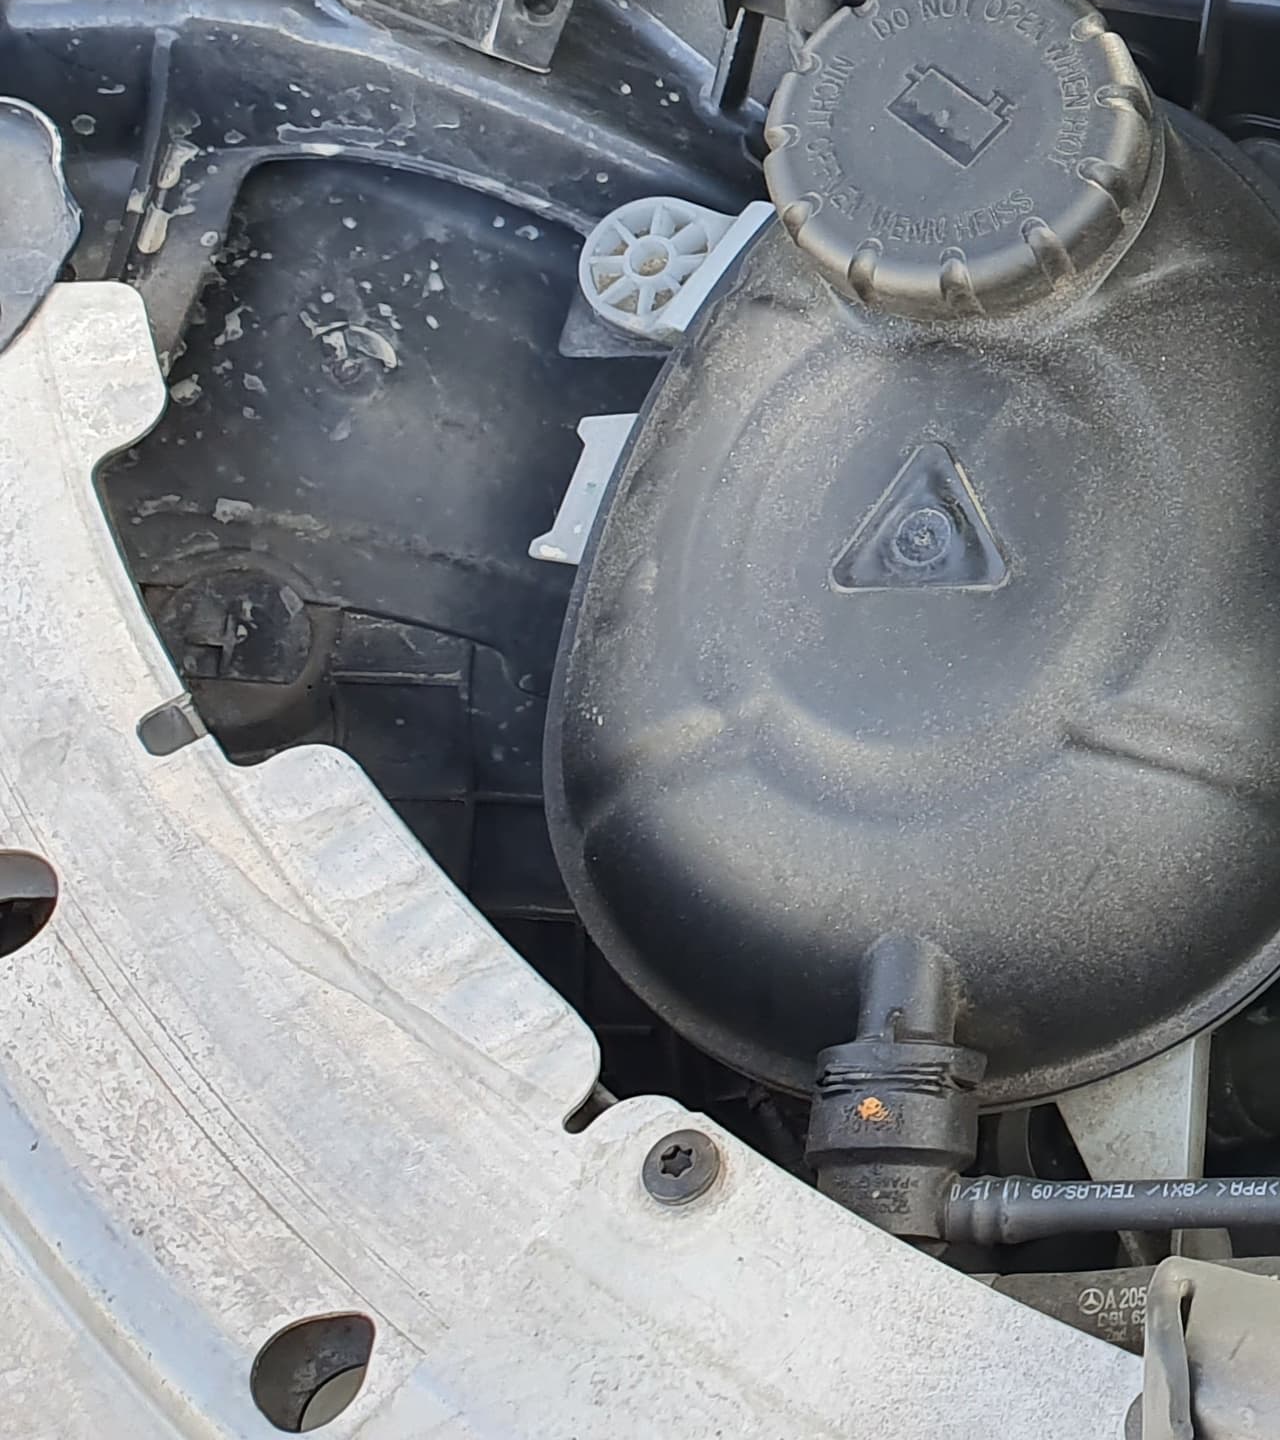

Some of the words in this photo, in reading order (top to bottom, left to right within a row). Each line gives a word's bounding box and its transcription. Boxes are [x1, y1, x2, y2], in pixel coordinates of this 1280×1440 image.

[871, 7, 911, 42] DO
[1040, 40, 1090, 112] WHEN
[807, 54, 856, 129] NICHT
[868, 205, 948, 244] WENN
[953, 189, 1034, 242] HEISS
[1047, 117, 1090, 173] HOT
[1104, 1288, 1116, 1309] A
